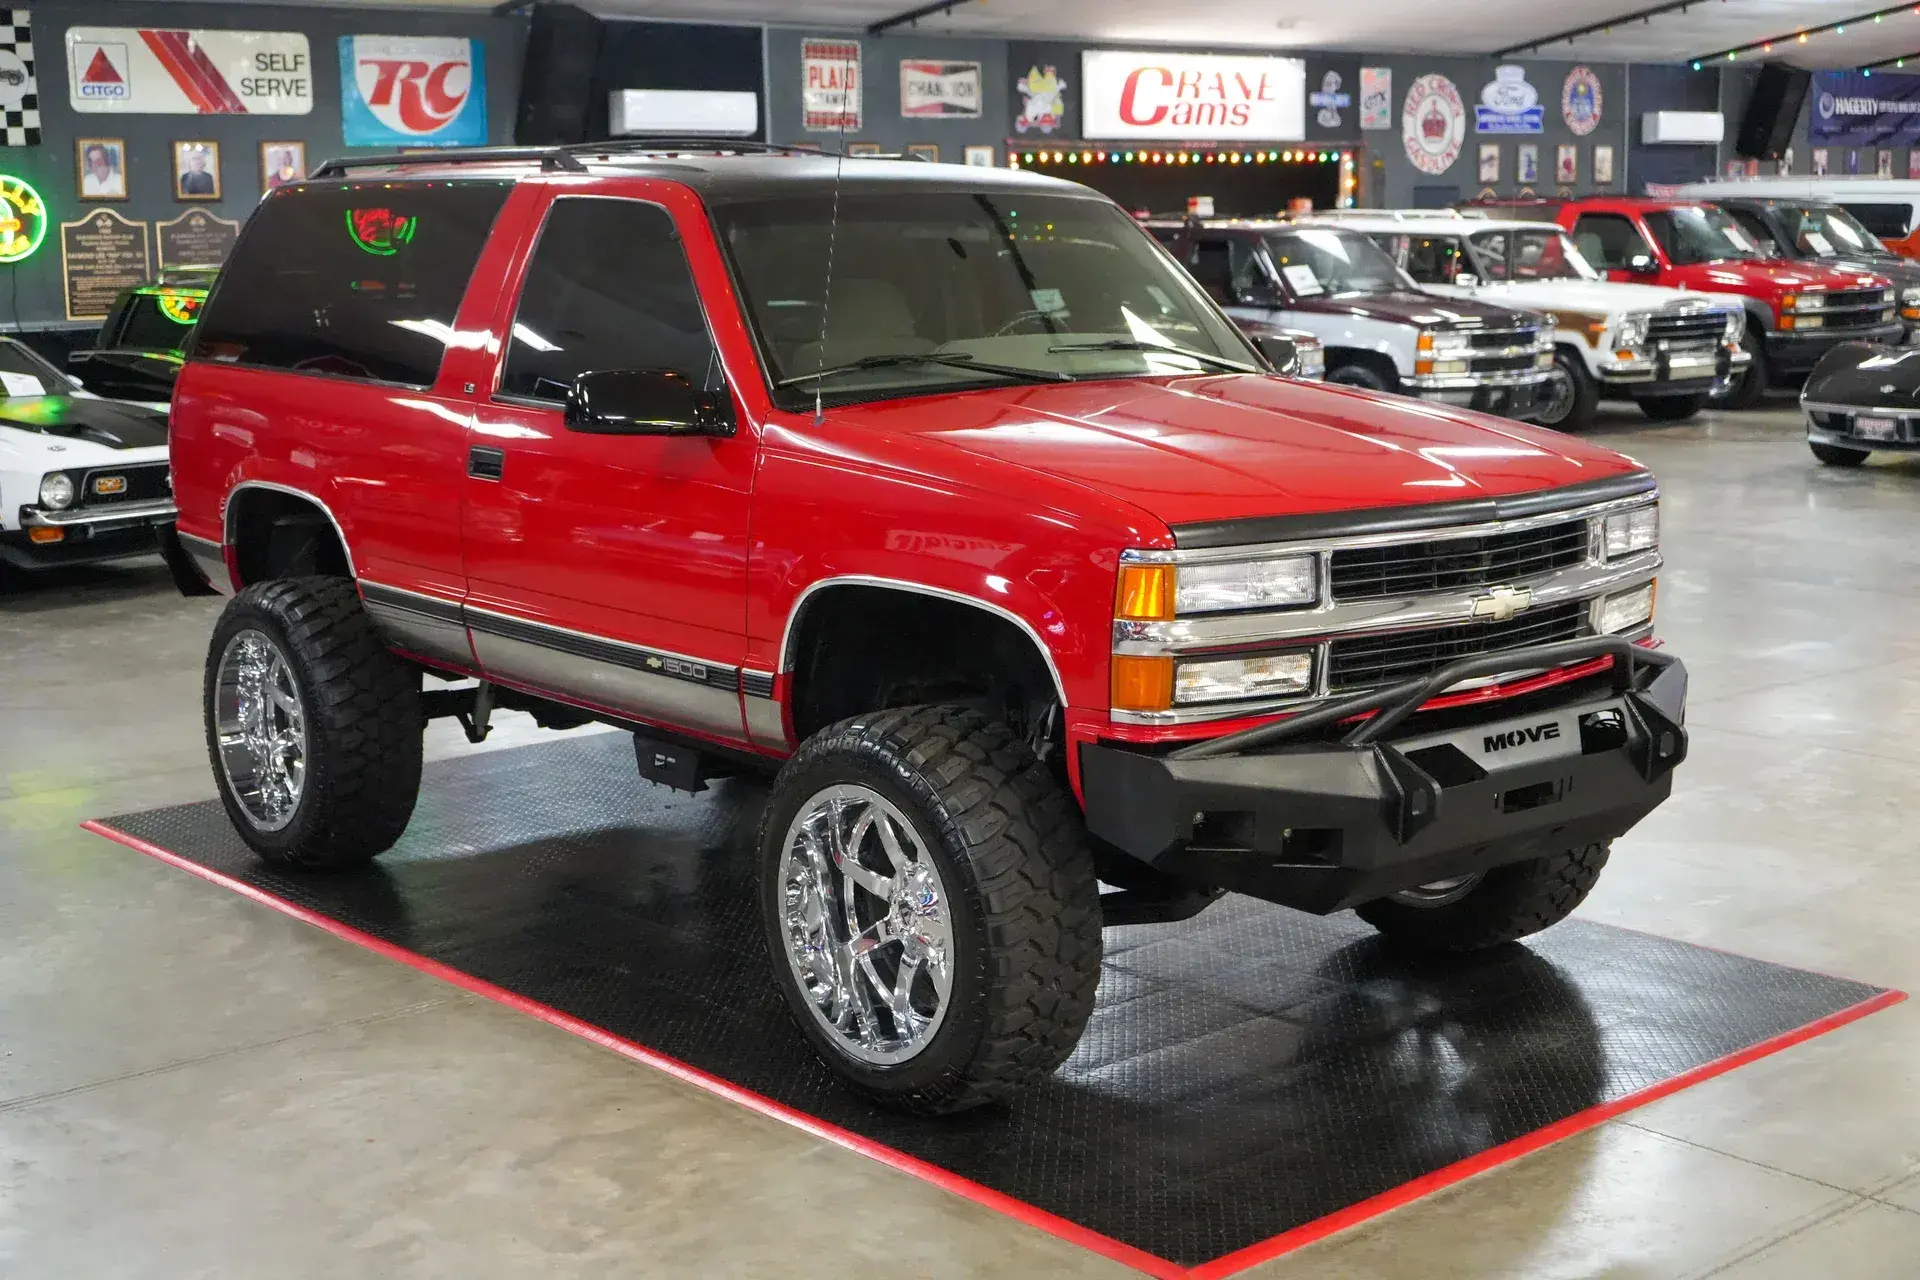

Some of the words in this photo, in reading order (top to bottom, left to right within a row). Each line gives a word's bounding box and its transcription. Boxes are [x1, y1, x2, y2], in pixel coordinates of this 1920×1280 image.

[255, 53, 306, 72] SELF
[82, 85, 125, 97] CITGO
[241, 77, 308, 97] SERVE
[359, 60, 469, 132] RC
[908, 80, 975, 97] CHAMION
[1834, 96, 1879, 116] HAGERTY
[1483, 722, 1561, 753] MOVE
